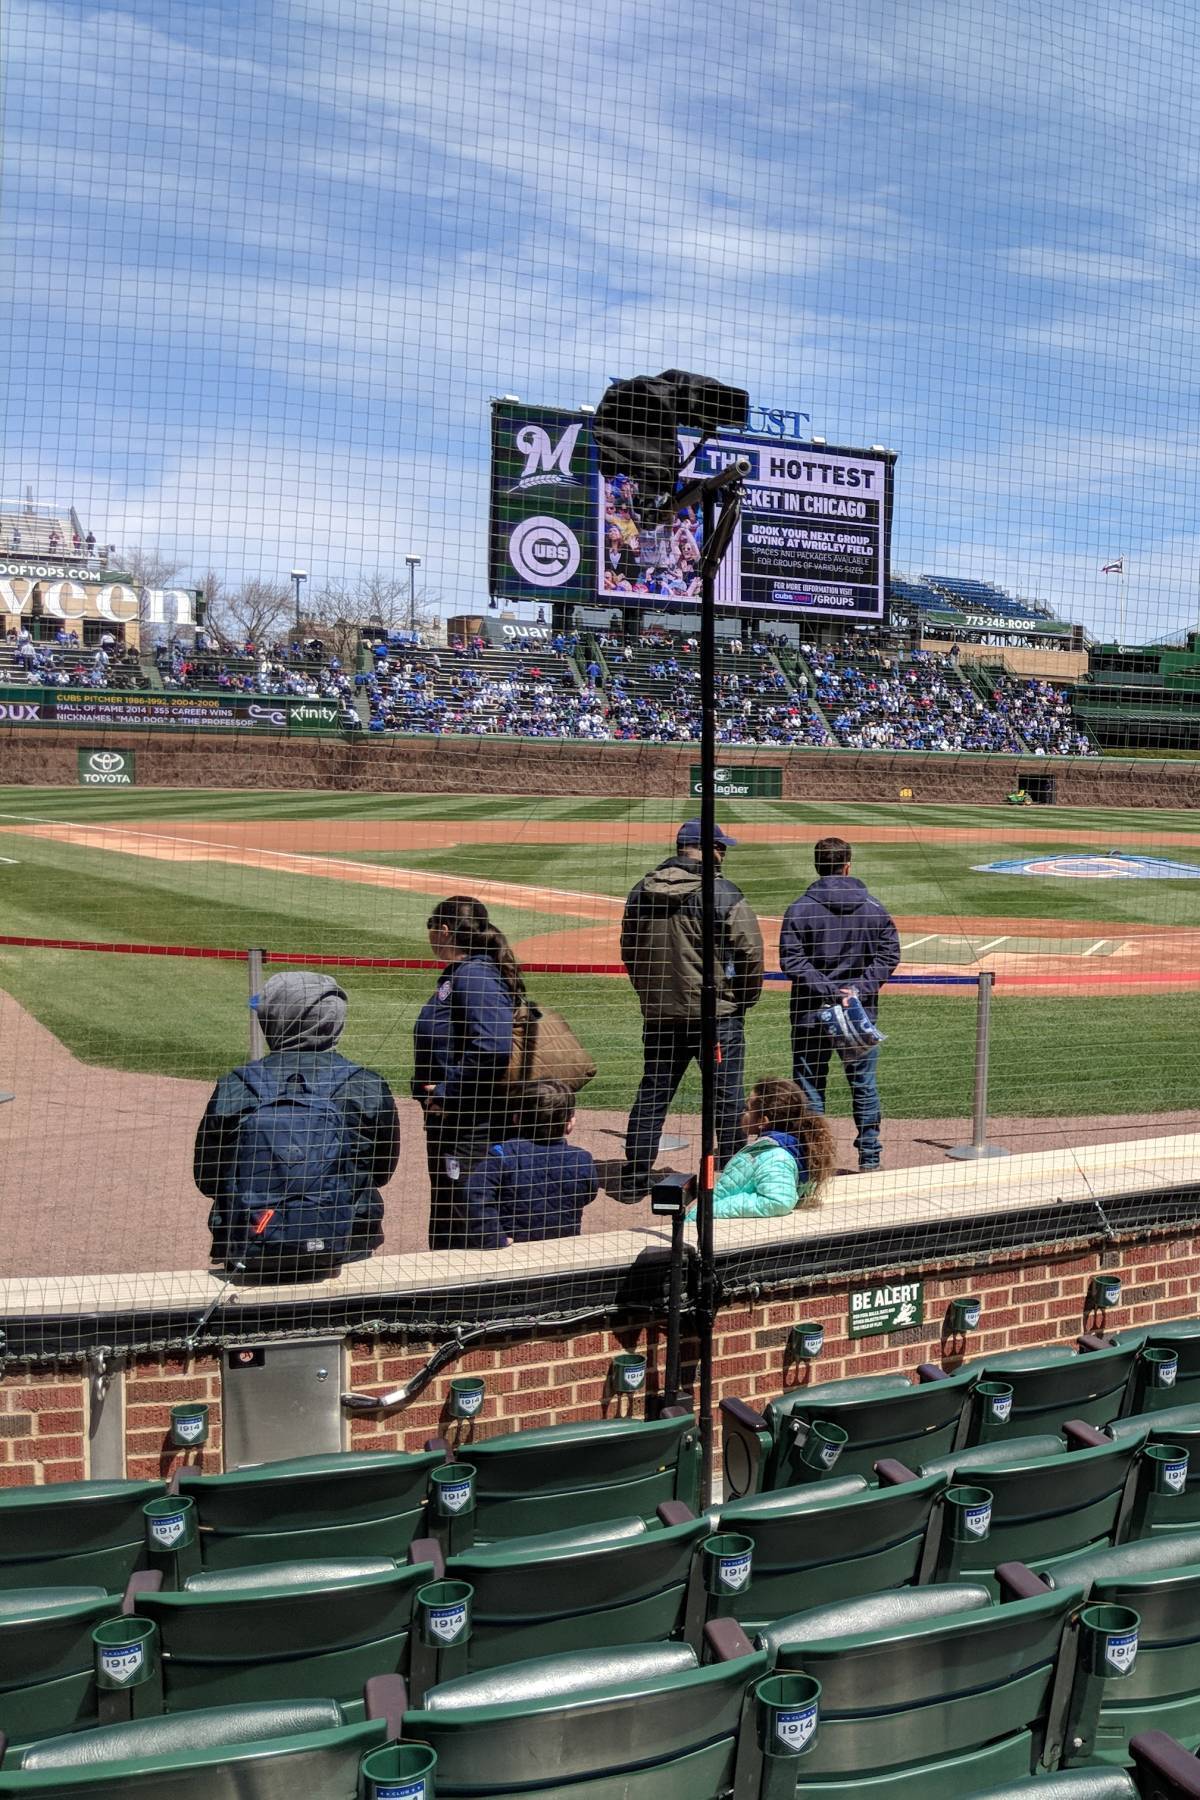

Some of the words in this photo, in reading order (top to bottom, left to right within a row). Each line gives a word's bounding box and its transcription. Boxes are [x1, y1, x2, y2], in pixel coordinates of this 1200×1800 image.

[769, 457, 875, 489] HOTTEST
[784, 491, 800, 511] IN
[803, 494, 867, 519] CHICAGO
[752, 525, 780, 537] BOOK
[781, 527, 809, 540] YOUR
[809, 530, 836, 543] NEXT
[837, 533, 870, 546] GROUP
[747, 534, 785, 547] OUTING
[786, 538, 800, 548] AT
[800, 540, 847, 554] WRIGLEY
[846, 545, 874, 556] FIELD
[751, 547, 779, 557] SPACES
[780, 550, 796, 558] AND
[796, 551, 833, 562] PACKAGES
[833, 554, 870, 566] AVAILABLE
[757, 558, 772, 566] FOR
[774, 559, 803, 569] GROUPS
[813, 563, 843, 573] VARIOUS
[844, 566, 864, 575] SIZES
[774, 581, 785, 589] FOR
[785, 582, 802, 591] MORE
[802, 583, 839, 595] INFORMATION
[965, 615, 1036, 631] 773-248-ROOF
[56, 694, 82, 702] CUBS
[83, 696, 123, 704] PITCHER
[0, 704, 41, 721] UX
[56, 703, 82, 712] HALL
[85, 704, 97, 712] OF
[99, 705, 124, 713] FAME
[126, 706, 147, 714] 2014
[153, 707, 170, 715] 355
[171, 708, 207, 716] CAREER
[209, 709, 233, 717] WINS
[290, 704, 338, 723] xfinity
[83, 773, 131, 784] TOYOTA
[694, 783, 750, 796] Glagher
[852, 1291, 872, 1312] BE
[874, 1282, 920, 1308] ALERT
[462, 1397, 480, 1406] 1914
[179, 1424, 200, 1432] 1914
[1168, 1470, 1185, 1480] 1914
[444, 1490, 467, 1500] 1914
[970, 1514, 990, 1526] 1914
[155, 1523, 181, 1535] 1914
[724, 1565, 749, 1577] 1914
[434, 1614, 462, 1629] 1914
[1111, 1645, 1137, 1657] 1914
[105, 1654, 138, 1668] 1914
[792, 1711, 808, 1720] CLUB
[782, 1718, 813, 1735] 1914
[391, 1789, 411, 1797] CLUB
